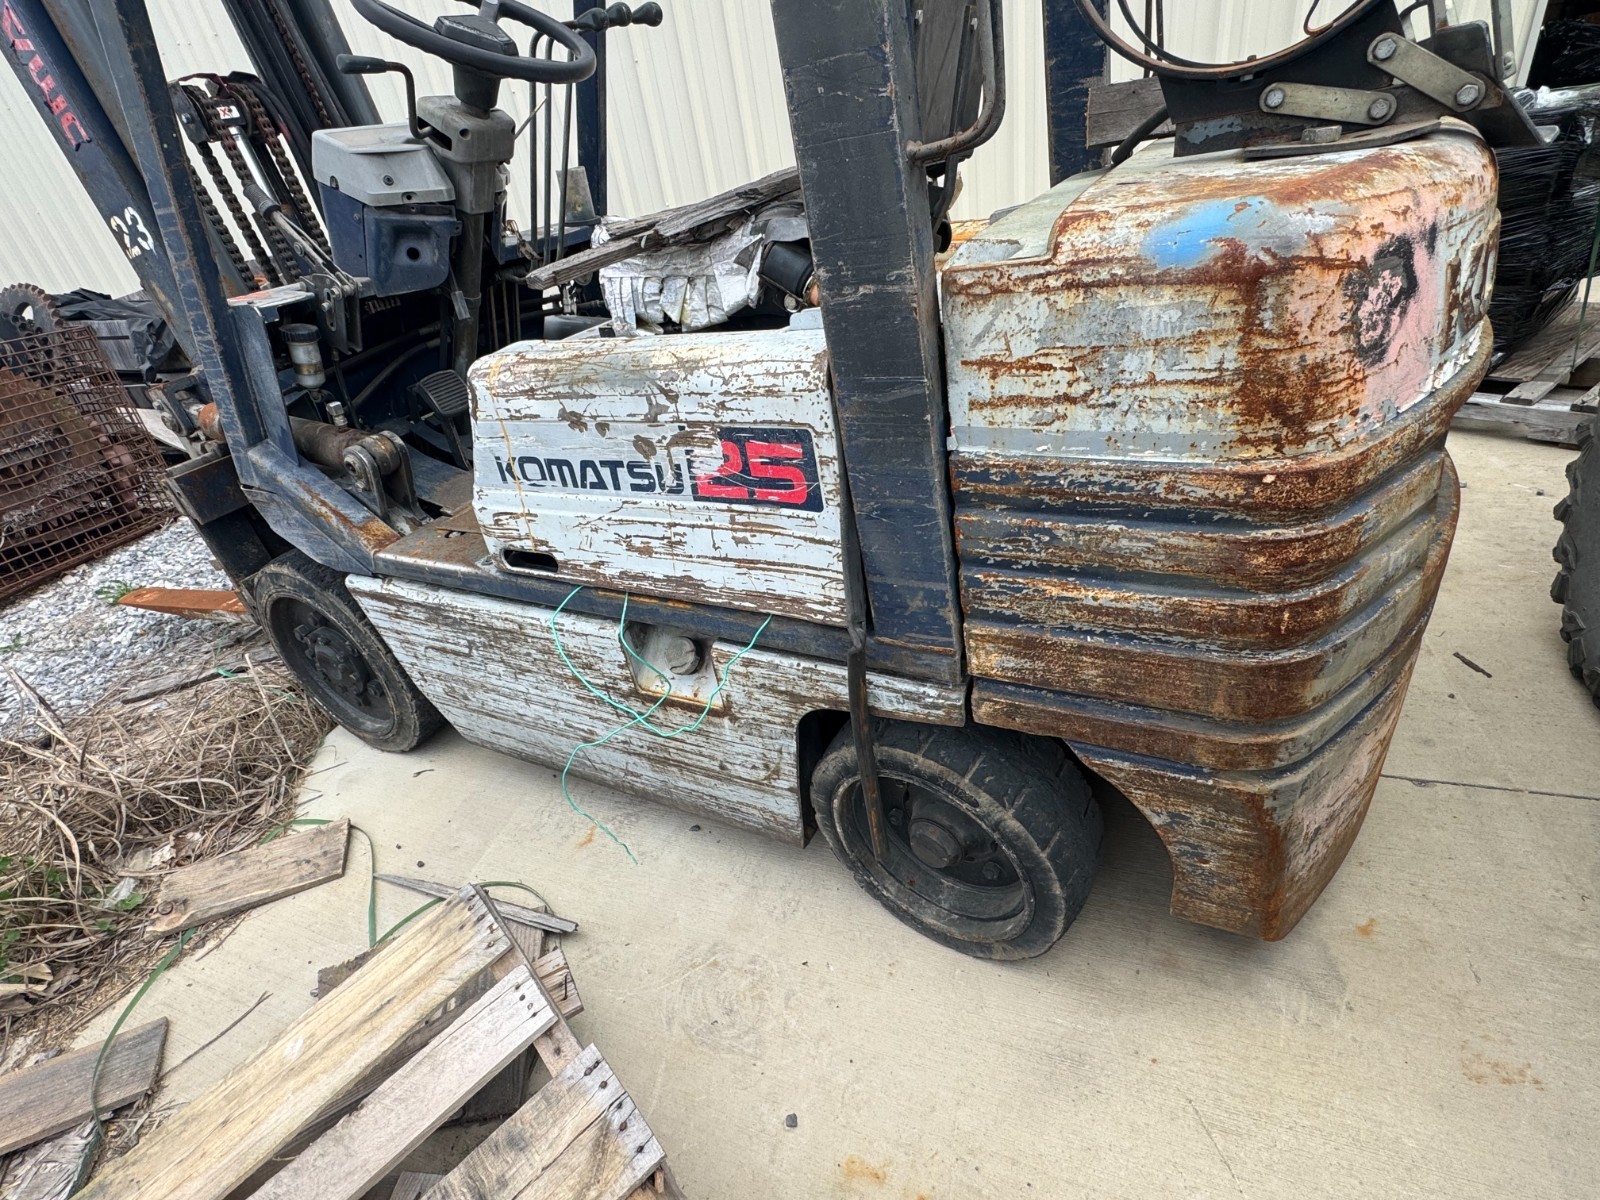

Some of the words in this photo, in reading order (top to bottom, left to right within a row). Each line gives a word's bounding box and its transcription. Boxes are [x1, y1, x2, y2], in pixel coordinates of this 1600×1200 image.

[110, 206, 156, 260] 23
[494, 455, 685, 495] KOMATSU
[696, 439, 808, 505] 25
